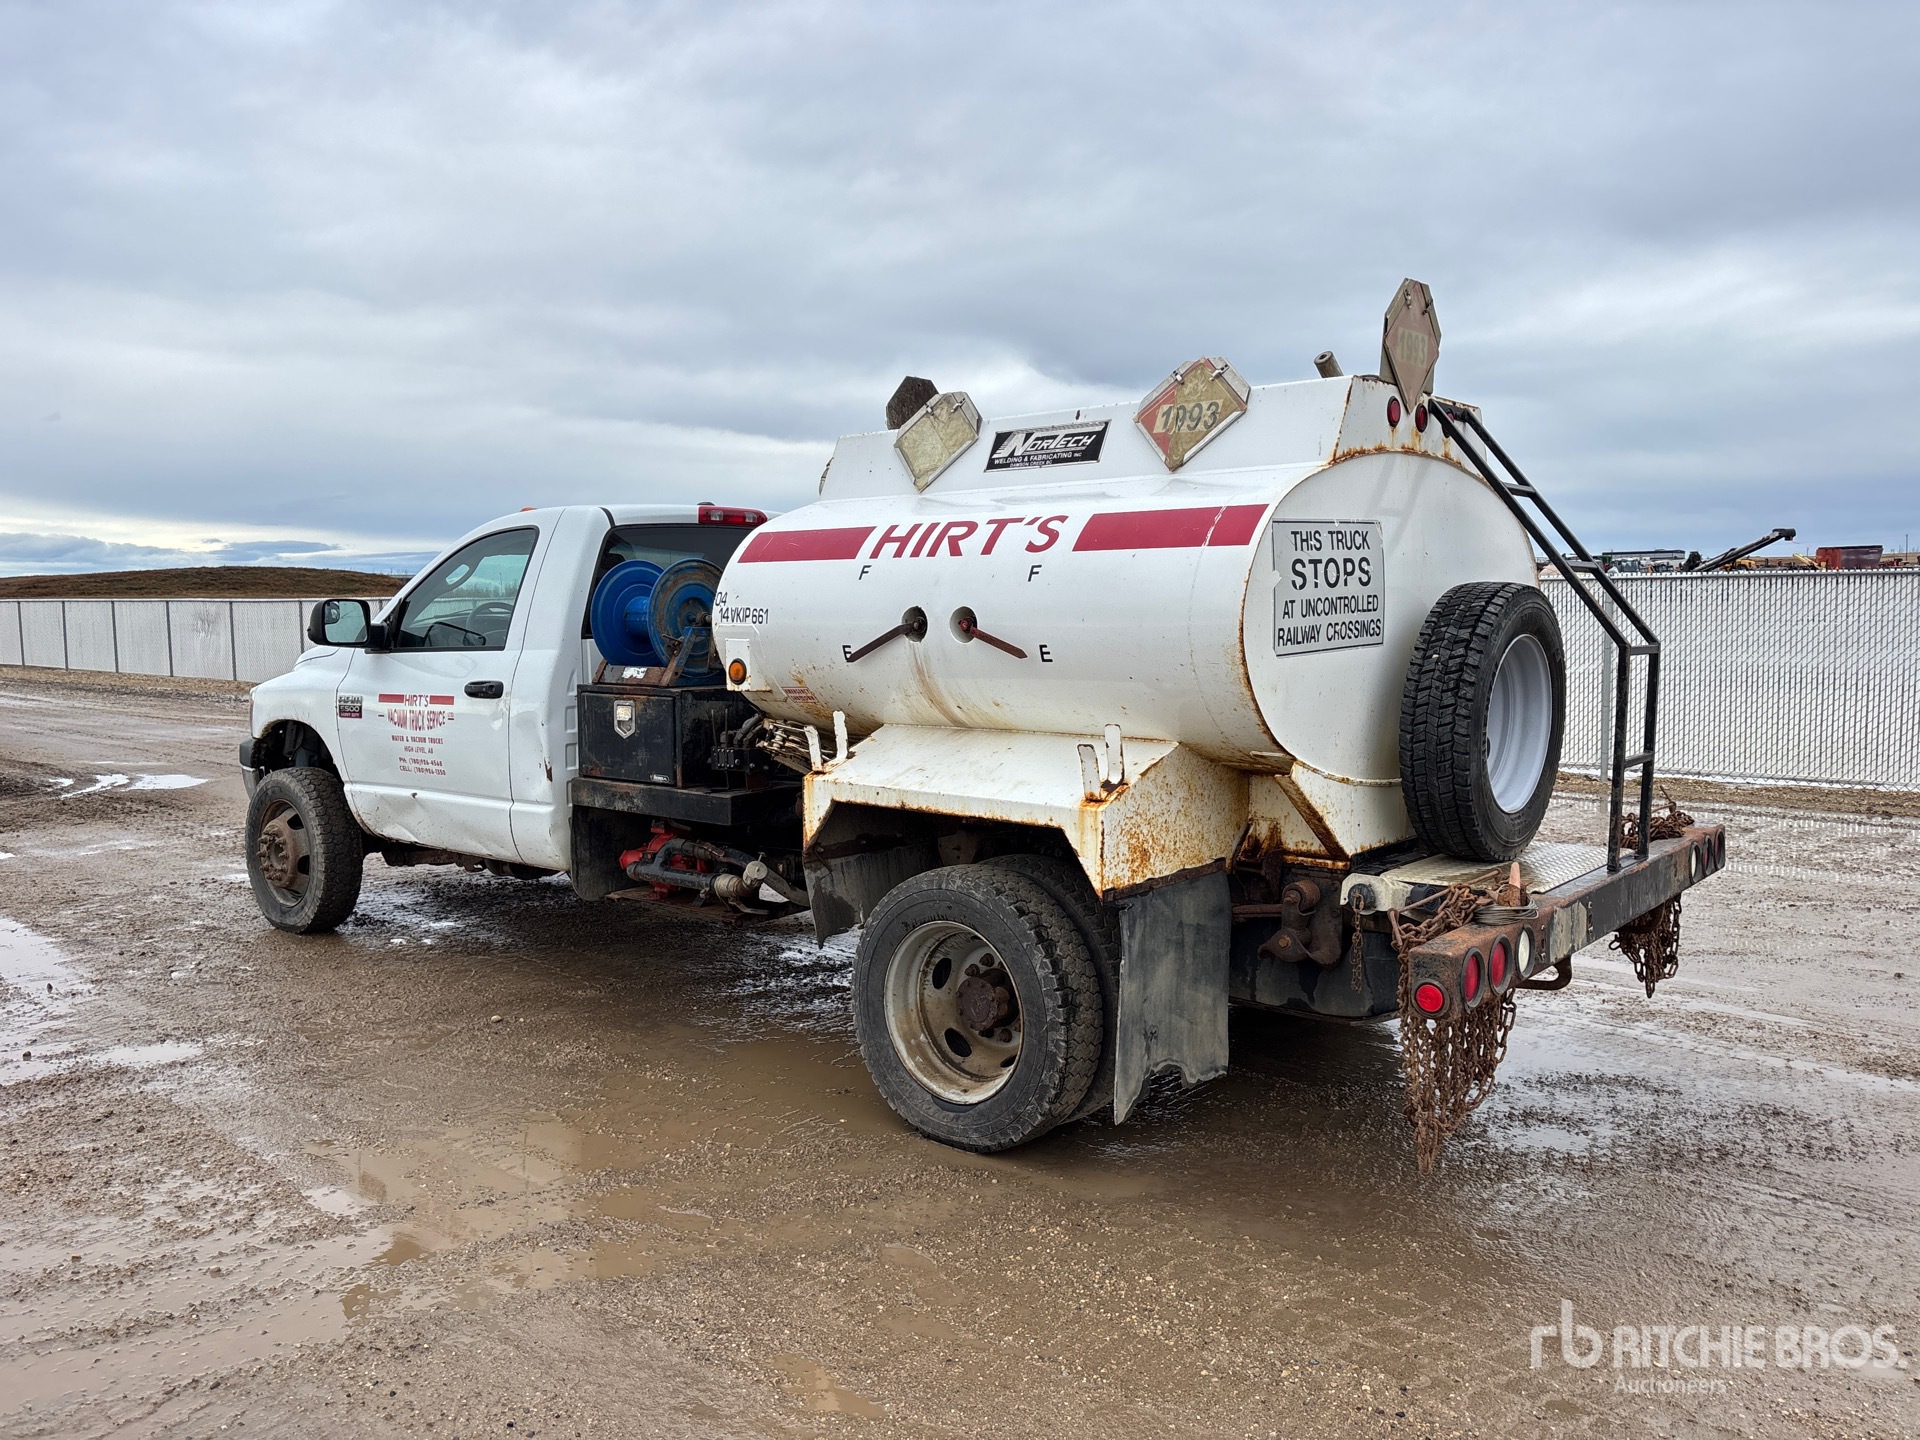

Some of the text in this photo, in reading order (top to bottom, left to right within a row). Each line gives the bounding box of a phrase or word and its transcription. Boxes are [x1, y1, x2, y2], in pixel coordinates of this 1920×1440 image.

[1161, 401, 1220, 432] 1993
[994, 456, 1023, 465] WELDING
[1029, 451, 1073, 461] FABRICATING
[869, 515, 1069, 559] HIRT'S
[1291, 530, 1370, 551] THIS TRUCK
[859, 565, 872, 580] F
[1027, 564, 1042, 582] F
[1291, 557, 1371, 590] STOPS
[1283, 594, 1379, 619] AT UNCONTROLLED
[1277, 618, 1381, 647] RAILWAY CROSSINGS
[842, 645, 852, 662] E
[1039, 644, 1053, 662] E
[404, 694, 429, 707] HIRT'S
[387, 709, 408, 730] VACUUM
[409, 709, 425, 731] TRUCK
[427, 710, 445, 730] SERVICE
